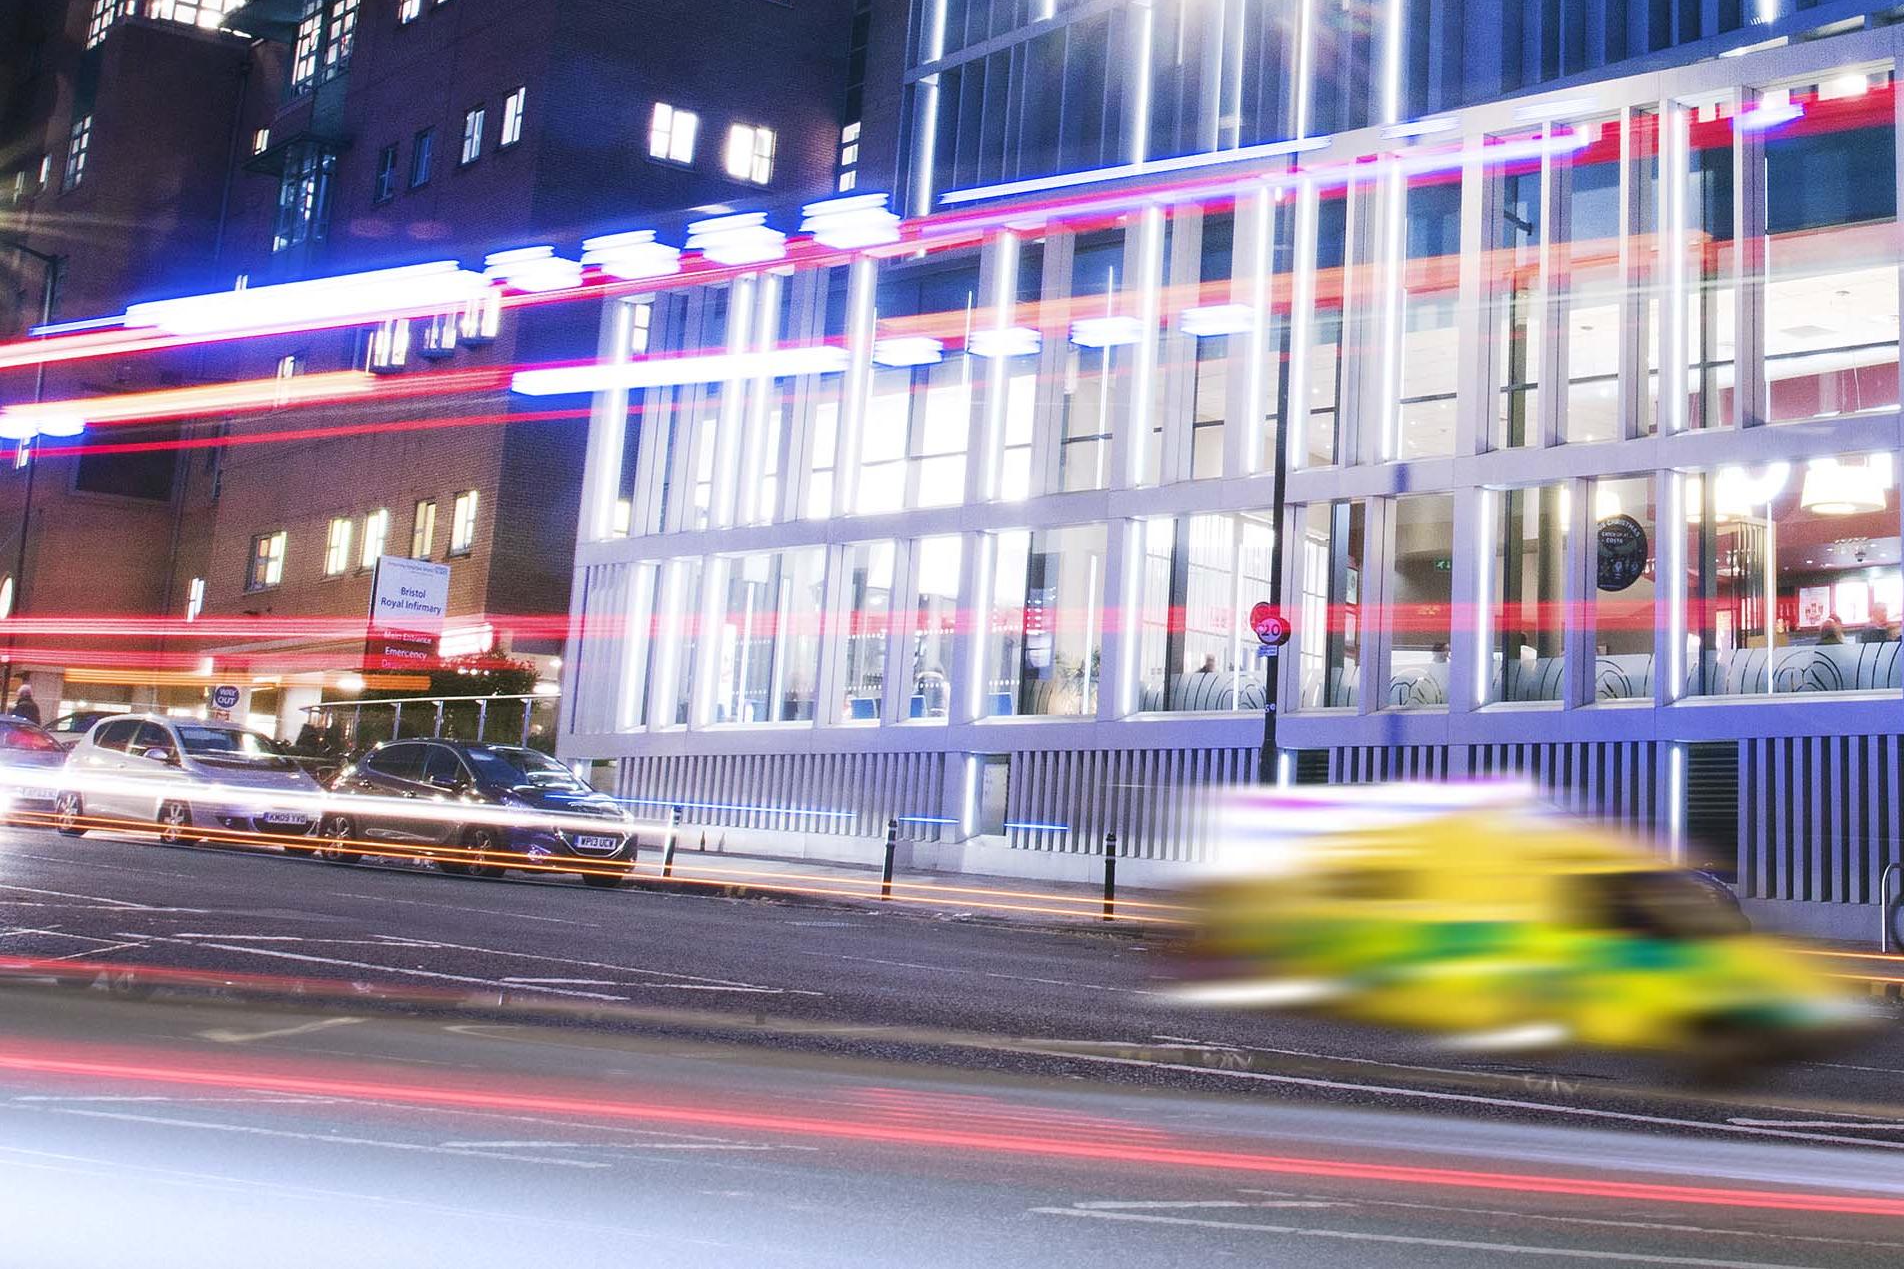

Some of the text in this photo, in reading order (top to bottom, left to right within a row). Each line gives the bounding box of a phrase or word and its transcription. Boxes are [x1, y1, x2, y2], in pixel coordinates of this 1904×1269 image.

[401, 587, 426, 598] Bristol
[381, 597, 442, 616] Royal Infirmary
[1260, 624, 1280, 637] 20
[218, 696, 236, 705] OUT
